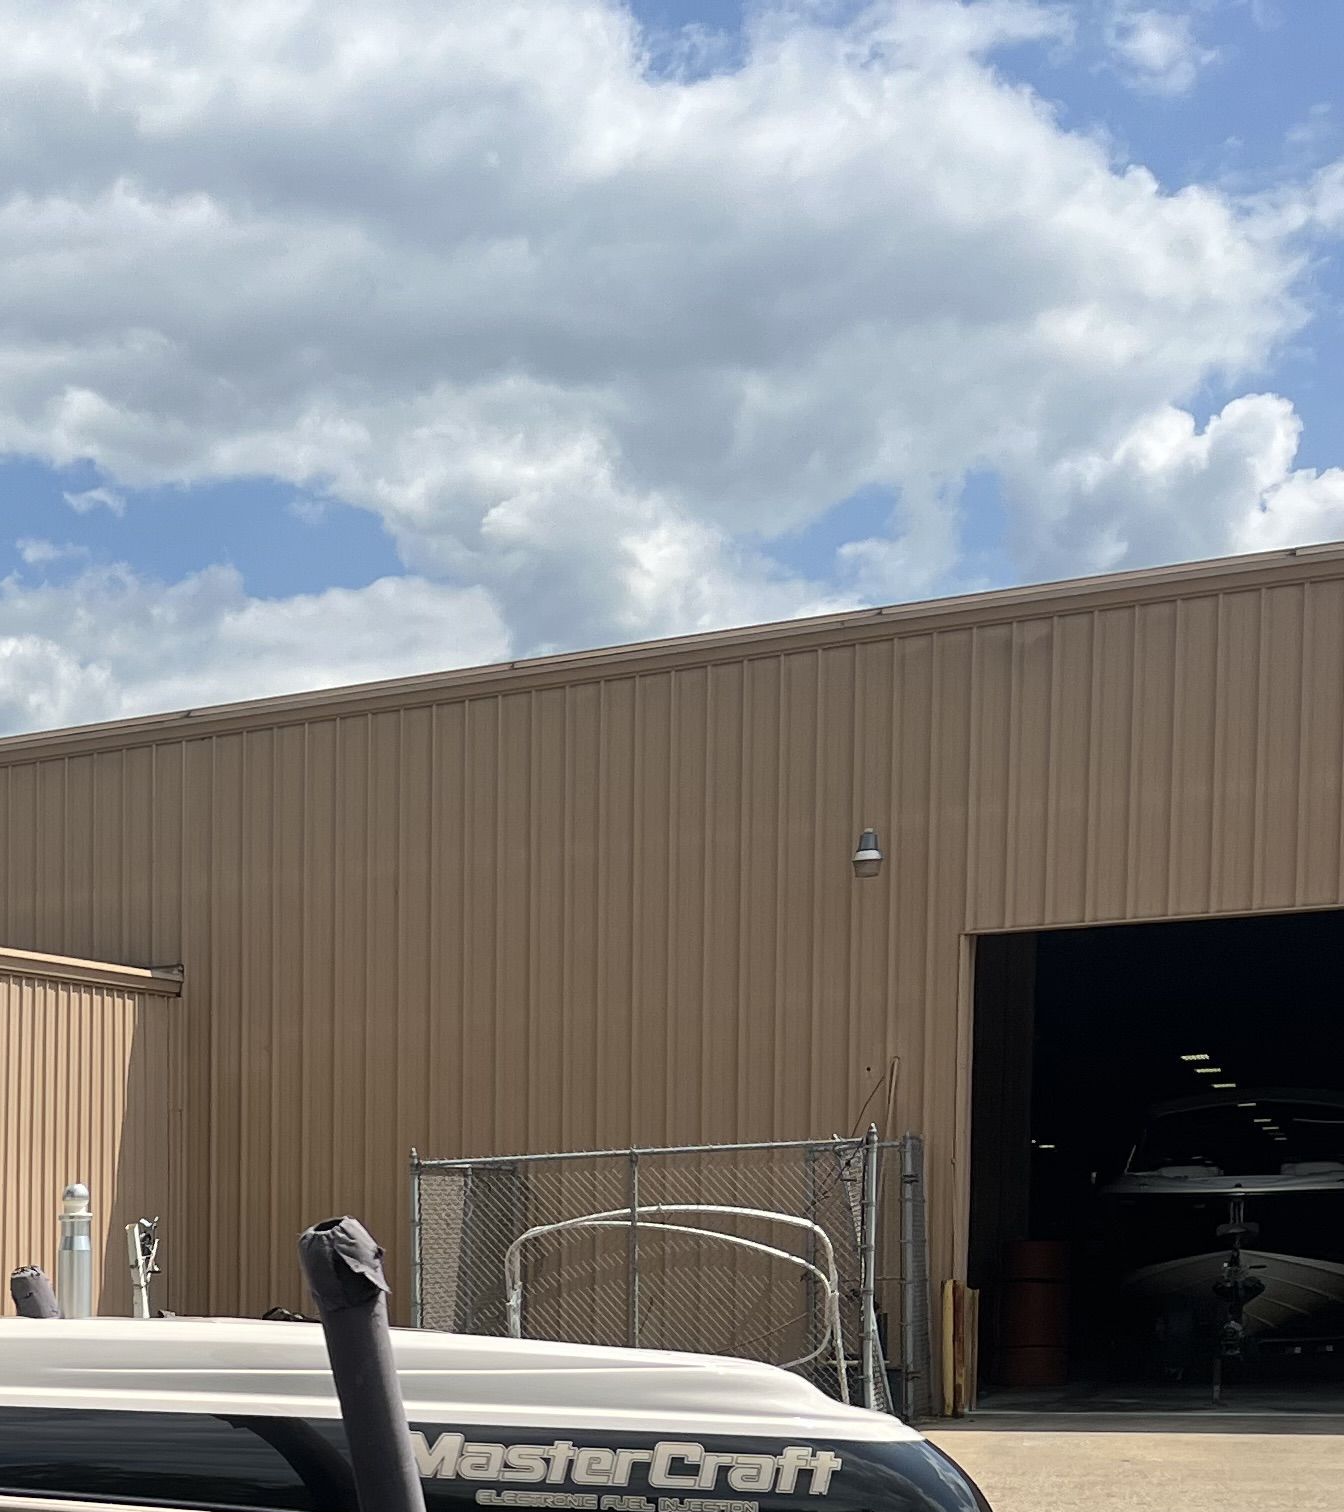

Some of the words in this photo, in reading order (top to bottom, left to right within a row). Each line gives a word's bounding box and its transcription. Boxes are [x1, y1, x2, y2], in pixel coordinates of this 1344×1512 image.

[410, 1430, 842, 1495] MasterCraft
[475, 1489, 598, 1511] ELECTRONIC
[600, 1494, 655, 1512] FUEL
